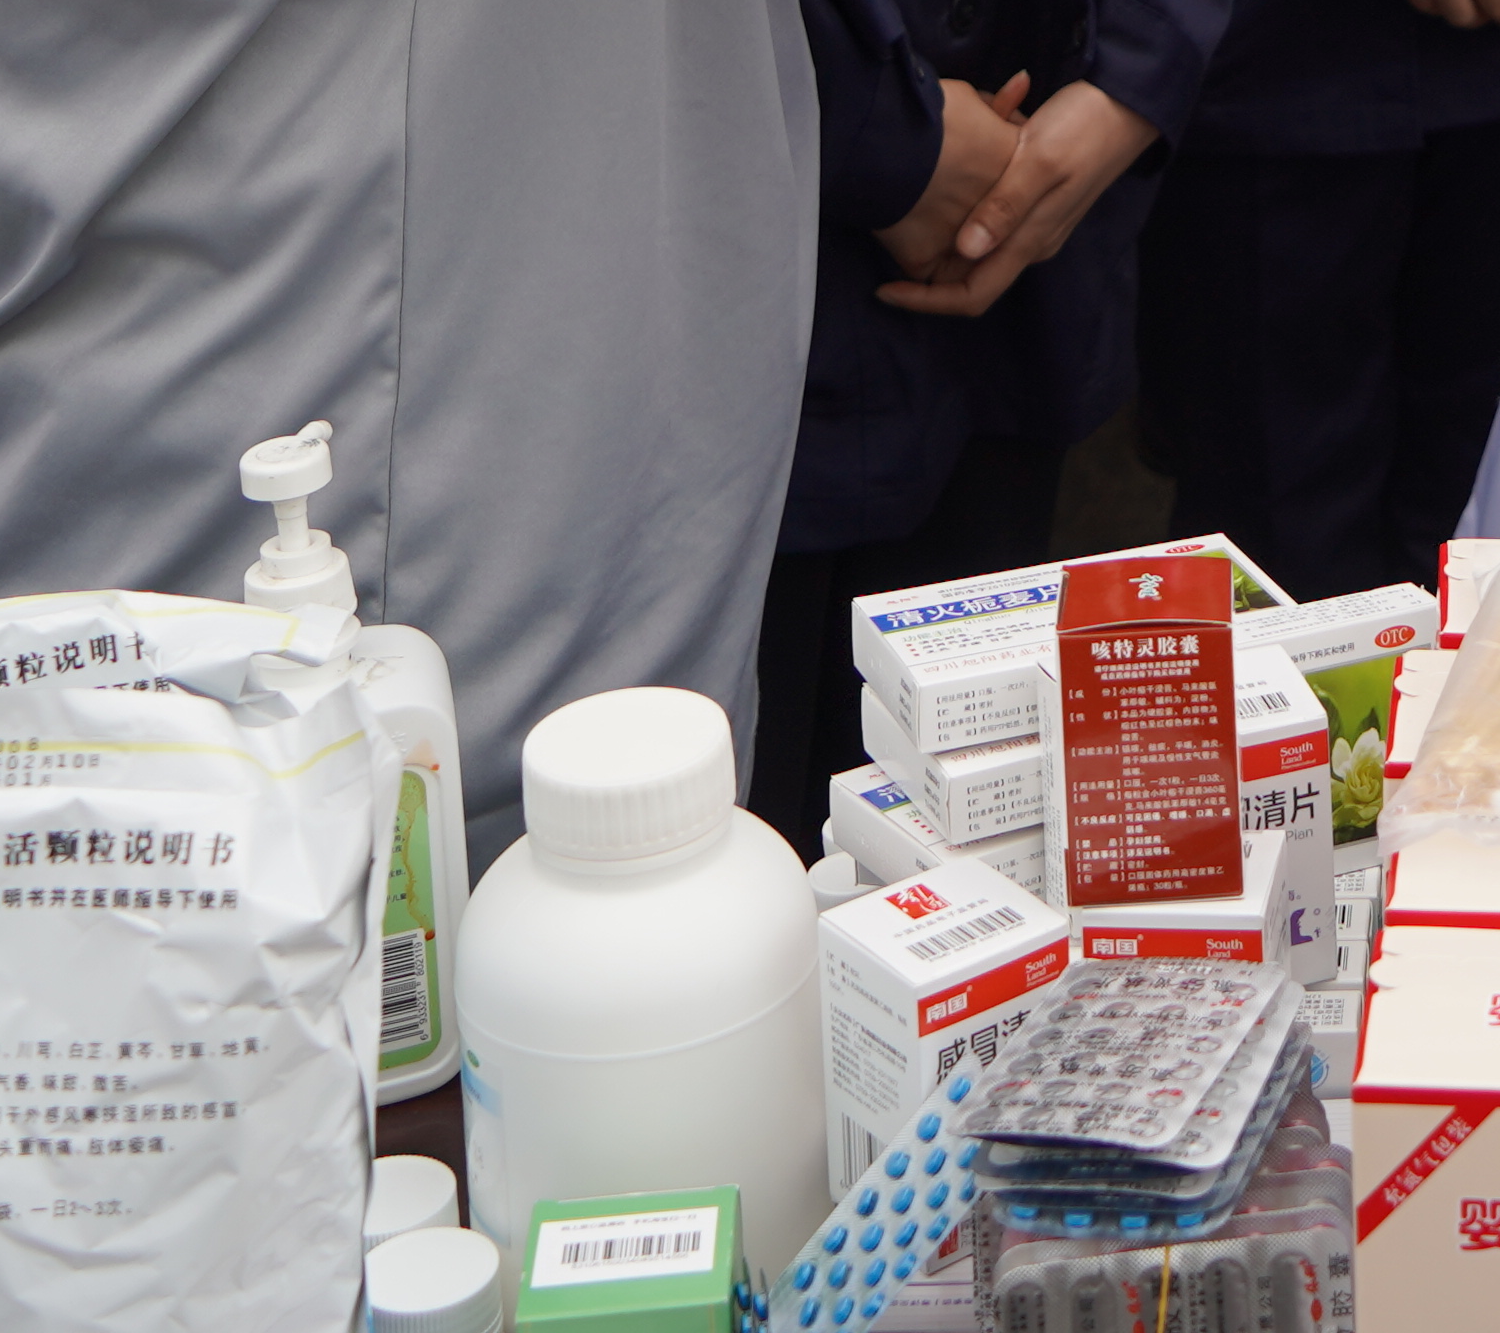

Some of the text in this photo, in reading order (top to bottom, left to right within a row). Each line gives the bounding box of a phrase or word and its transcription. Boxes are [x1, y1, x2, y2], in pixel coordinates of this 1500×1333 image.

[887, 583, 1060, 629] 清火栀麦片
[1380, 626, 1410, 645] OTC
[1091, 634, 1201, 660] 咳特灵胶囊
[1279, 741, 1314, 758] South
[1281, 752, 1303, 765] Land
[1243, 781, 1320, 832] 清片
[1206, 939, 1244, 950] South
[1025, 952, 1058, 974] South
[1027, 967, 1047, 982] Land
